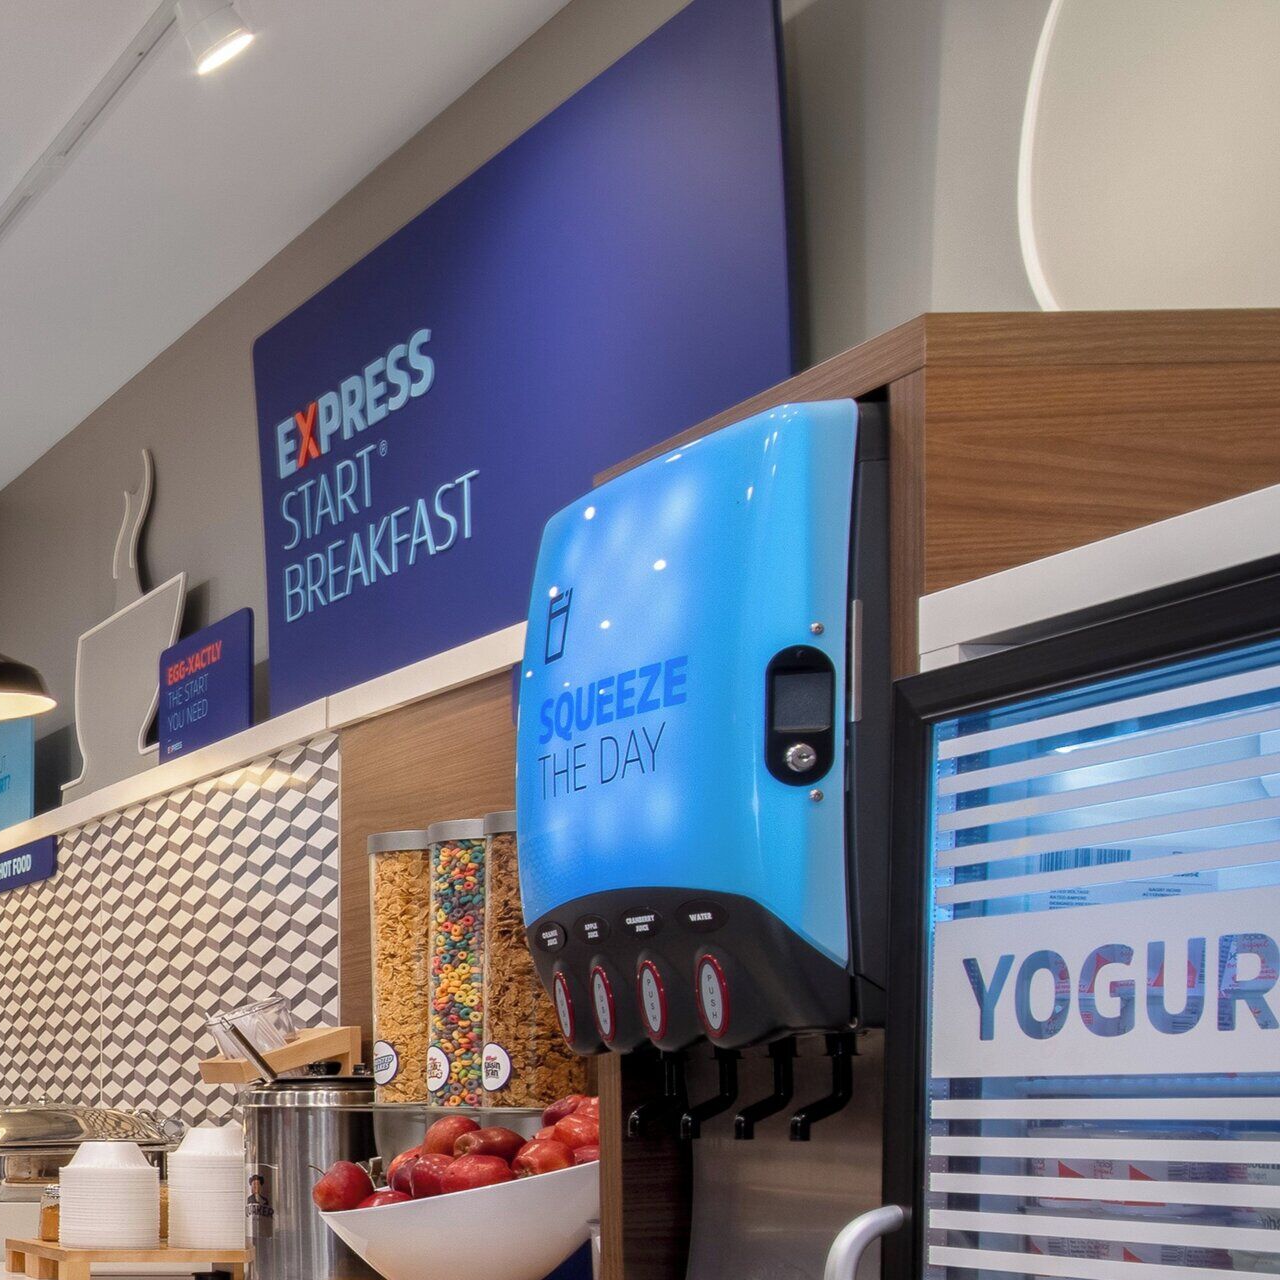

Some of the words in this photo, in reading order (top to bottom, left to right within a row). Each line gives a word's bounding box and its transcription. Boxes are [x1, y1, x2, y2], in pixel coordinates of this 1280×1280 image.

[274, 328, 436, 480] EXPRESS
[283, 470, 481, 623] BREAKFAST
[167, 640, 222, 686] EGG-XACTLY
[168, 687, 183, 709] THE
[185, 673, 208, 702] START
[539, 655, 689, 745] SQUEEZE
[167, 709, 185, 732] YOU
[187, 699, 209, 723] NEED
[538, 740, 588, 800] THE
[600, 721, 667, 786] DAY
[12, 854, 32, 876] FOOD
[625, 915, 655, 925] CRANBERRY
[688, 912, 713, 922] WATER
[597, 983, 608, 1025] PUSH
[646, 978, 658, 1022] PUSH
[706, 974, 718, 1020] PUSH
